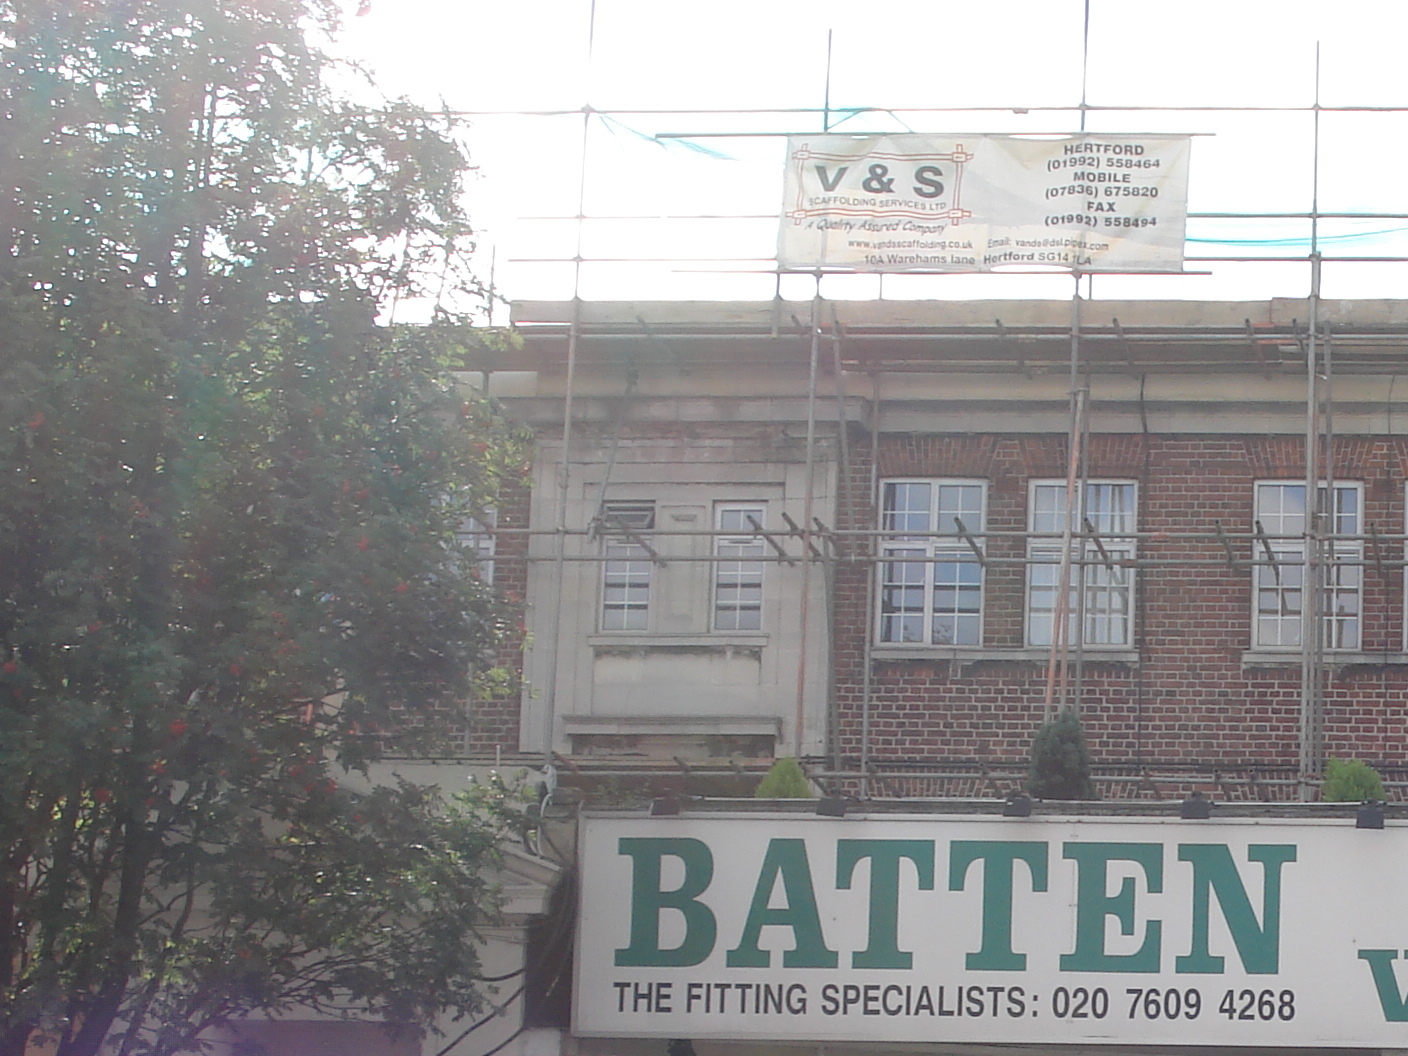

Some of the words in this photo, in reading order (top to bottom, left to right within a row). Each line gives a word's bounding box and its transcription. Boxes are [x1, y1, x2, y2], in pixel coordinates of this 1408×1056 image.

[1064, 143, 1144, 155] HERTFORD
[1047, 156, 1100, 172] (01992)
[1106, 158, 1160, 169] 558464
[815, 164, 849, 192] V
[862, 163, 895, 194] &
[913, 165, 944, 199] S
[1073, 171, 1131, 183] MOBILE
[1045, 184, 1098, 200] (07836)
[1104, 186, 1158, 198] 675820
[808, 196, 877, 207] SCAFFOLDING
[879, 199, 926, 210] SERVICES
[929, 201, 947, 211] LTD
[1087, 201, 1116, 212] FAX
[816, 219, 856, 235] Quality
[859, 219, 899, 232] Assured
[902, 221, 947, 237] Company
[1044, 214, 1098, 228] (01992)
[1104, 217, 1157, 228] 558494
[887, 254, 947, 265] Warehams
[951, 254, 975, 265] lane
[984, 252, 1034, 265] Hertford
[1038, 252, 1069, 263] SG14
[614, 836, 1297, 975] BATTEN
[614, 982, 673, 1014] THE
[686, 982, 808, 1016] FITTING
[820, 983, 1040, 1019] SPECIALISTS:
[1052, 987, 1109, 1020] 020
[1127, 987, 1201, 1021] 7609
[1218, 988, 1296, 1022] 4268
